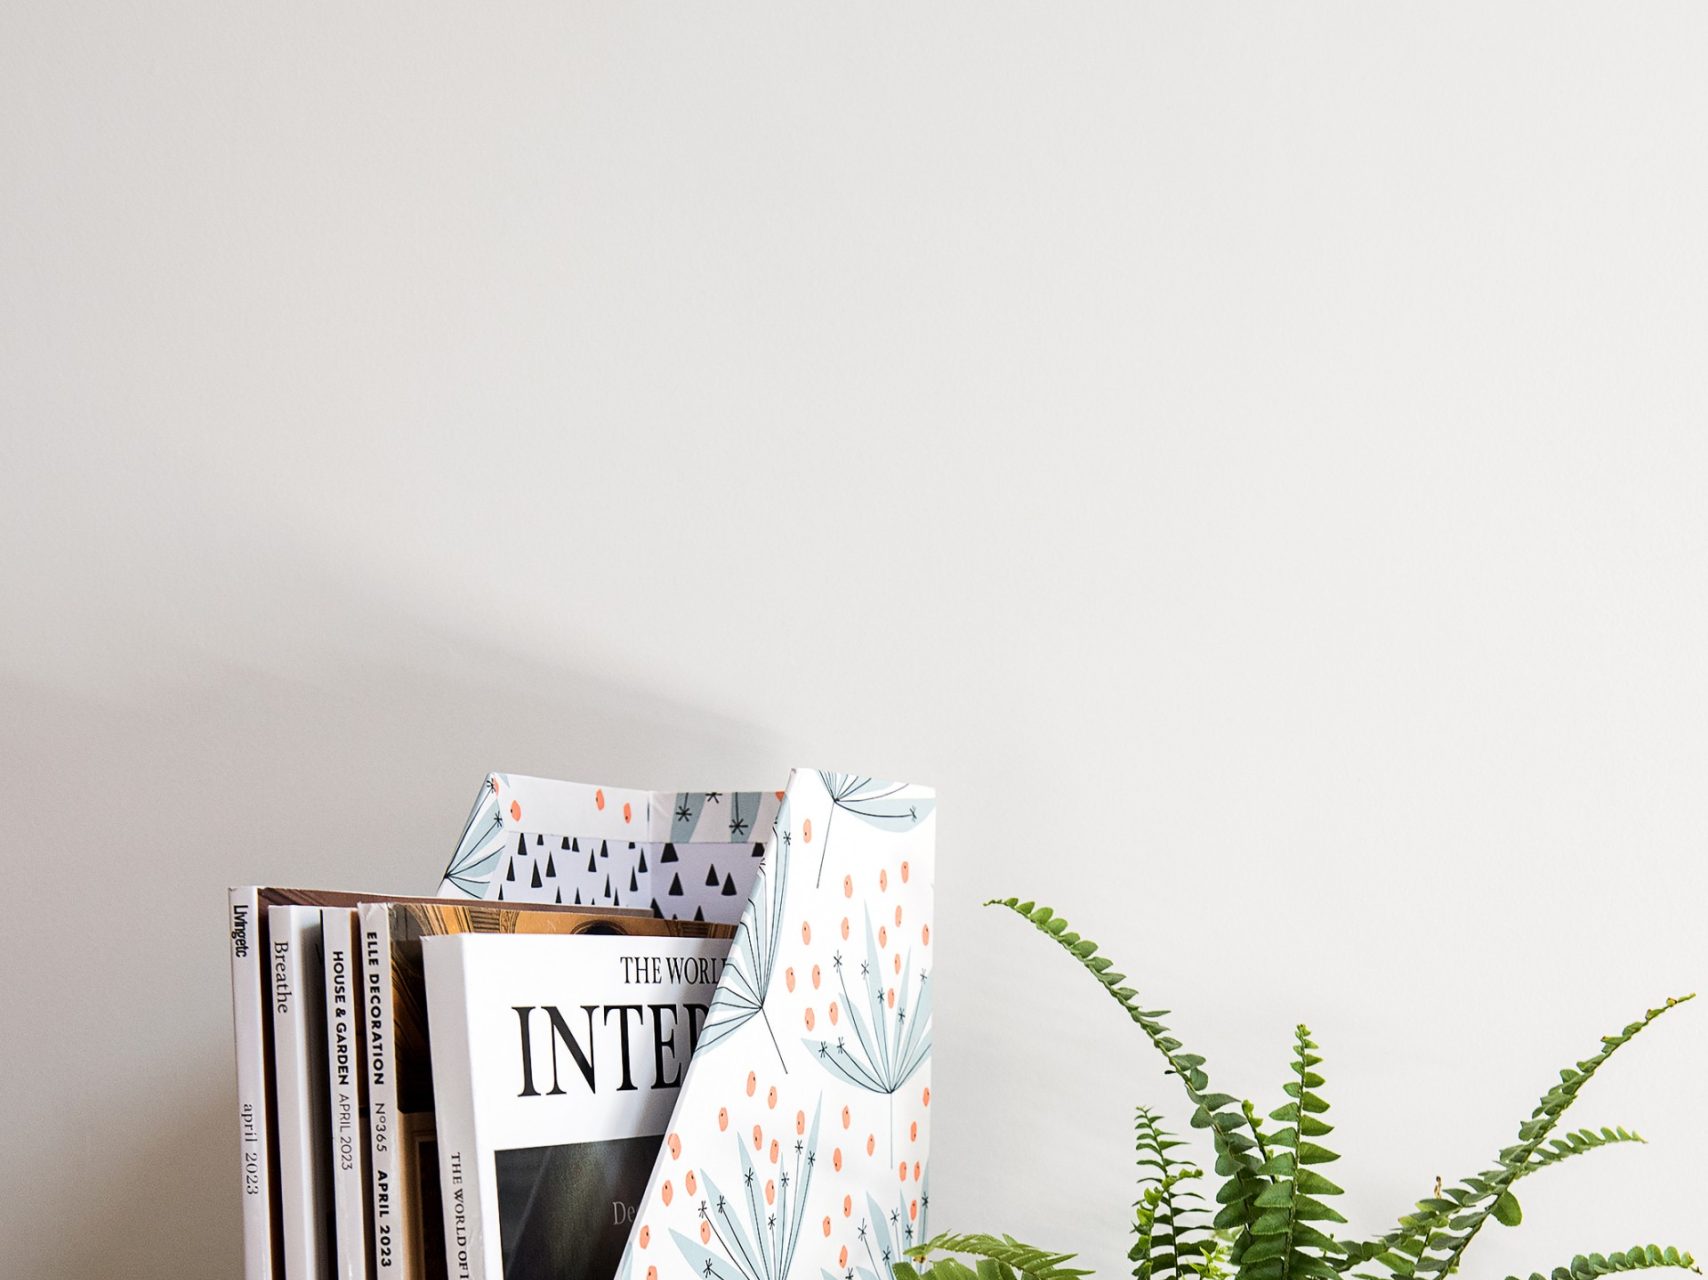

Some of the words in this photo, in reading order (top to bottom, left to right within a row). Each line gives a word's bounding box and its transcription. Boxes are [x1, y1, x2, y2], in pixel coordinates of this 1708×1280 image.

[366, 931, 379, 966] ELLE
[273, 941, 292, 1014] Breathe
[332, 951, 346, 1004] HOUSE
[619, 956, 662, 985] THE
[666, 956, 728, 985] WORL
[335, 1007, 347, 1018] &
[368, 973, 385, 1085] DECORATION
[335, 1022, 350, 1085] GARDEN
[241, 1103, 258, 1142] april
[338, 1093, 351, 1133] APRIL
[245, 1152, 259, 1195] 2023
[340, 1136, 353, 1171] 2023
[451, 1151, 463, 1184] THE
[377, 1169, 390, 1218] APRIL
[453, 1188, 467, 1247] WORLD
[379, 1224, 392, 1268] 2023
[457, 1250, 469, 1271] OF
